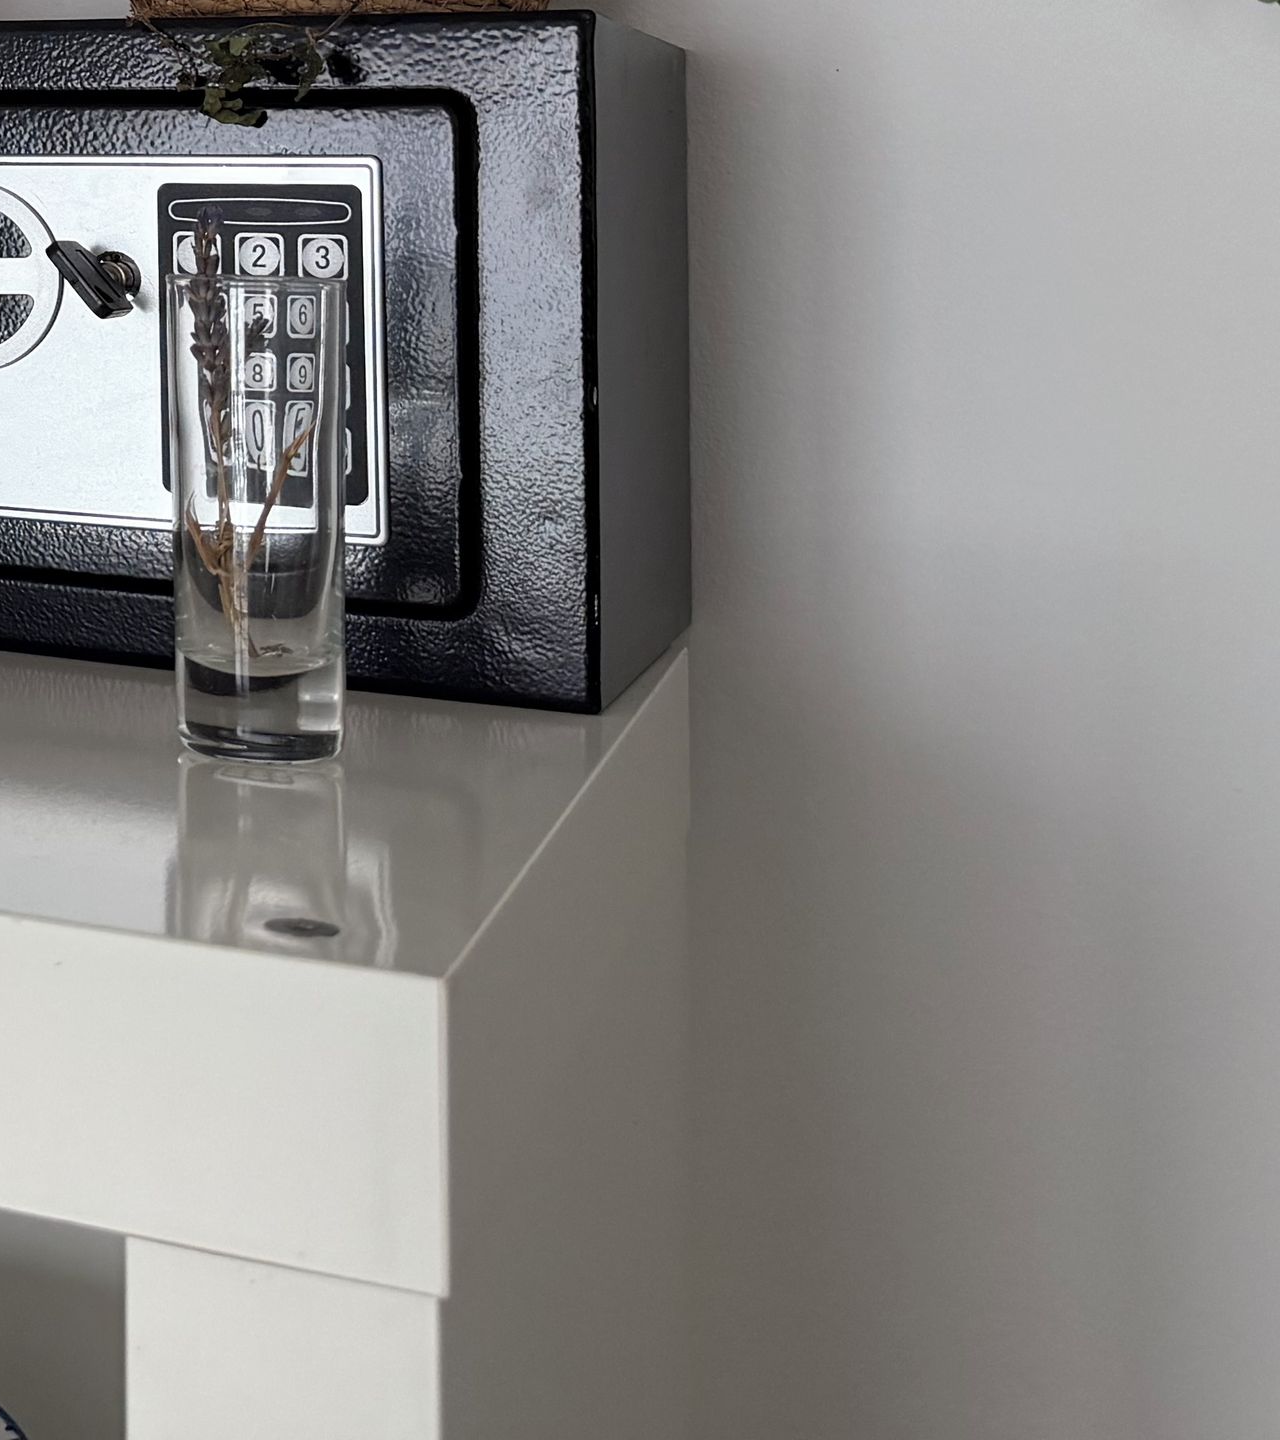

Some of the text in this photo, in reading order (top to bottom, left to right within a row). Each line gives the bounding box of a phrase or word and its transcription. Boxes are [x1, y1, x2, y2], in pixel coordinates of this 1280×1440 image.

[251, 244, 331, 270] 2 3
[297, 304, 308, 326] 6
[252, 363, 308, 385] 8 9
